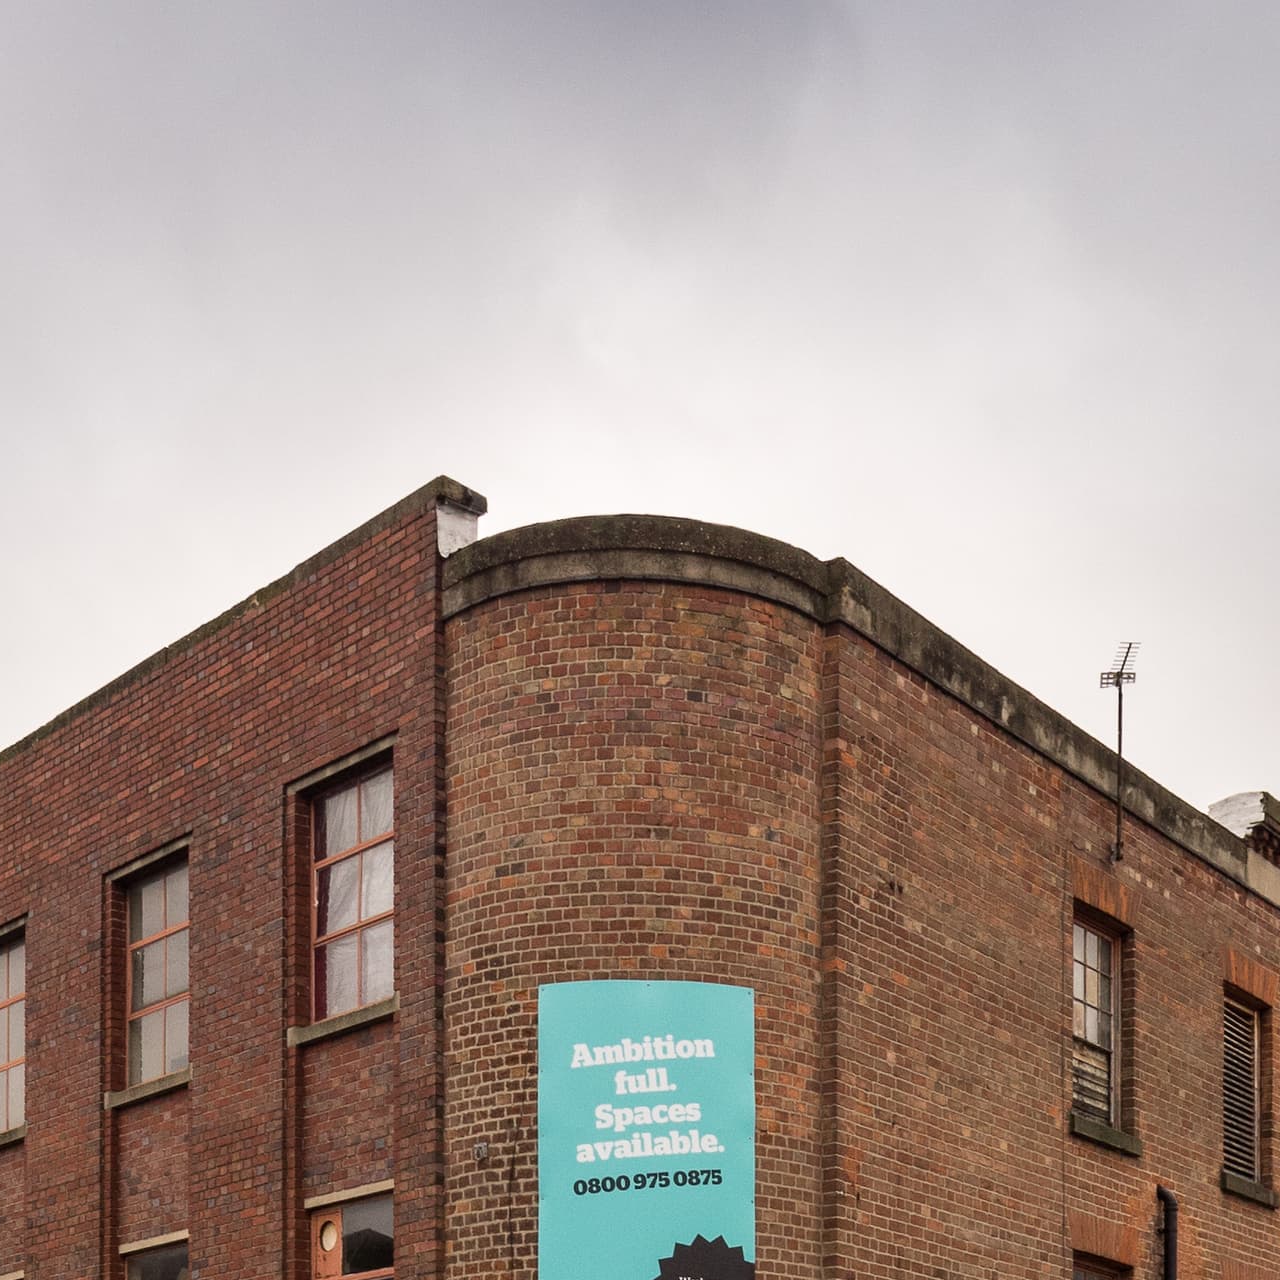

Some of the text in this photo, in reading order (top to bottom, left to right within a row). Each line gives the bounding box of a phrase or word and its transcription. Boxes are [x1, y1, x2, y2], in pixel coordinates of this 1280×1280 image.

[571, 1034, 715, 1068] Ambition
[615, 1068, 677, 1094] full.
[595, 1103, 701, 1132] Spaces
[576, 1130, 725, 1163] available.
[573, 1169, 723, 1195] 0800 975 0875
